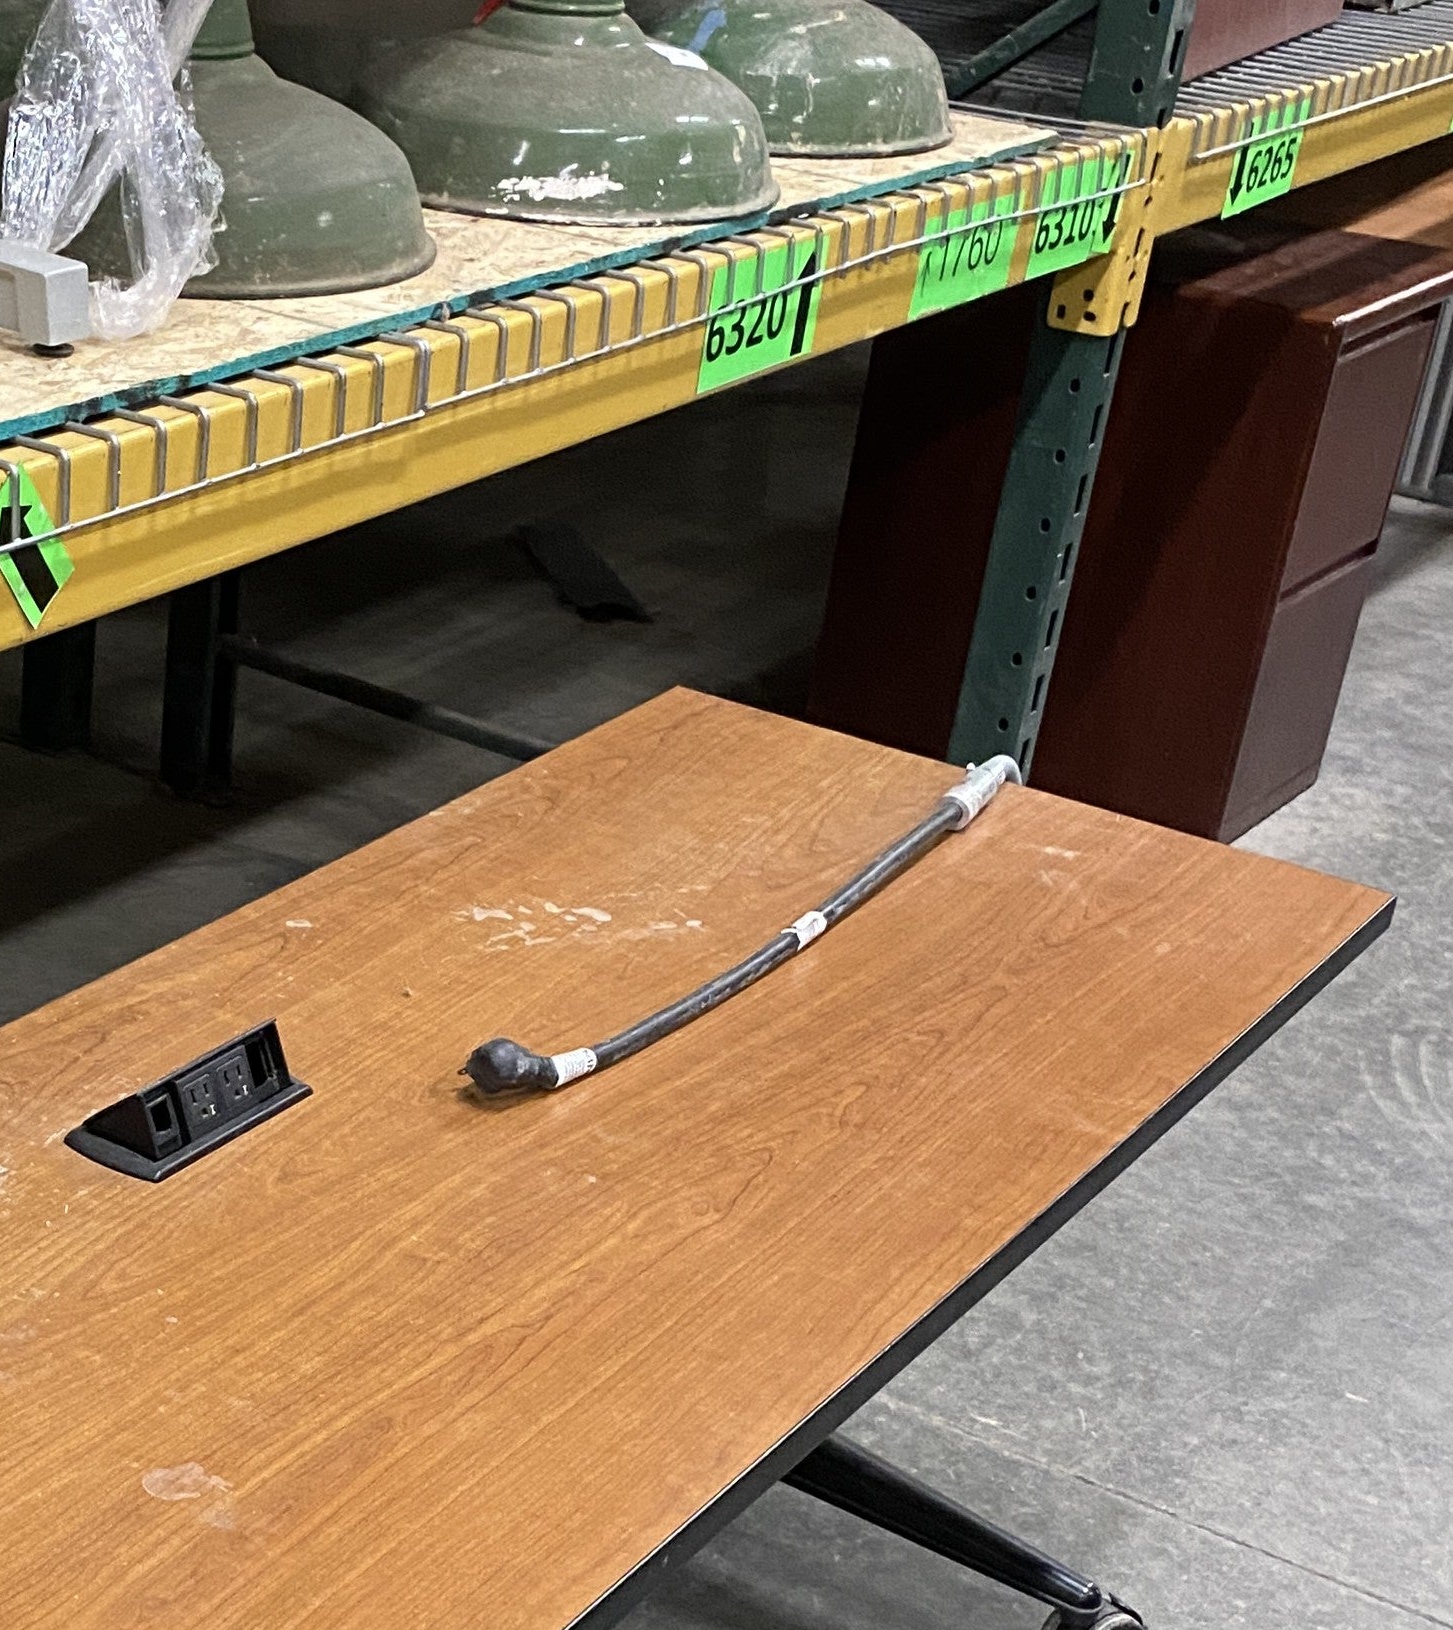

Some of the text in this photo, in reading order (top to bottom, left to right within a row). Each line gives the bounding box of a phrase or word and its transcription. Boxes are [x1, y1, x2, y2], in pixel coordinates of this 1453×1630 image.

[1246, 136, 1298, 193] 6265
[938, 214, 1003, 281] 1760
[1035, 197, 1096, 254] 6310
[706, 284, 788, 362] 6320
